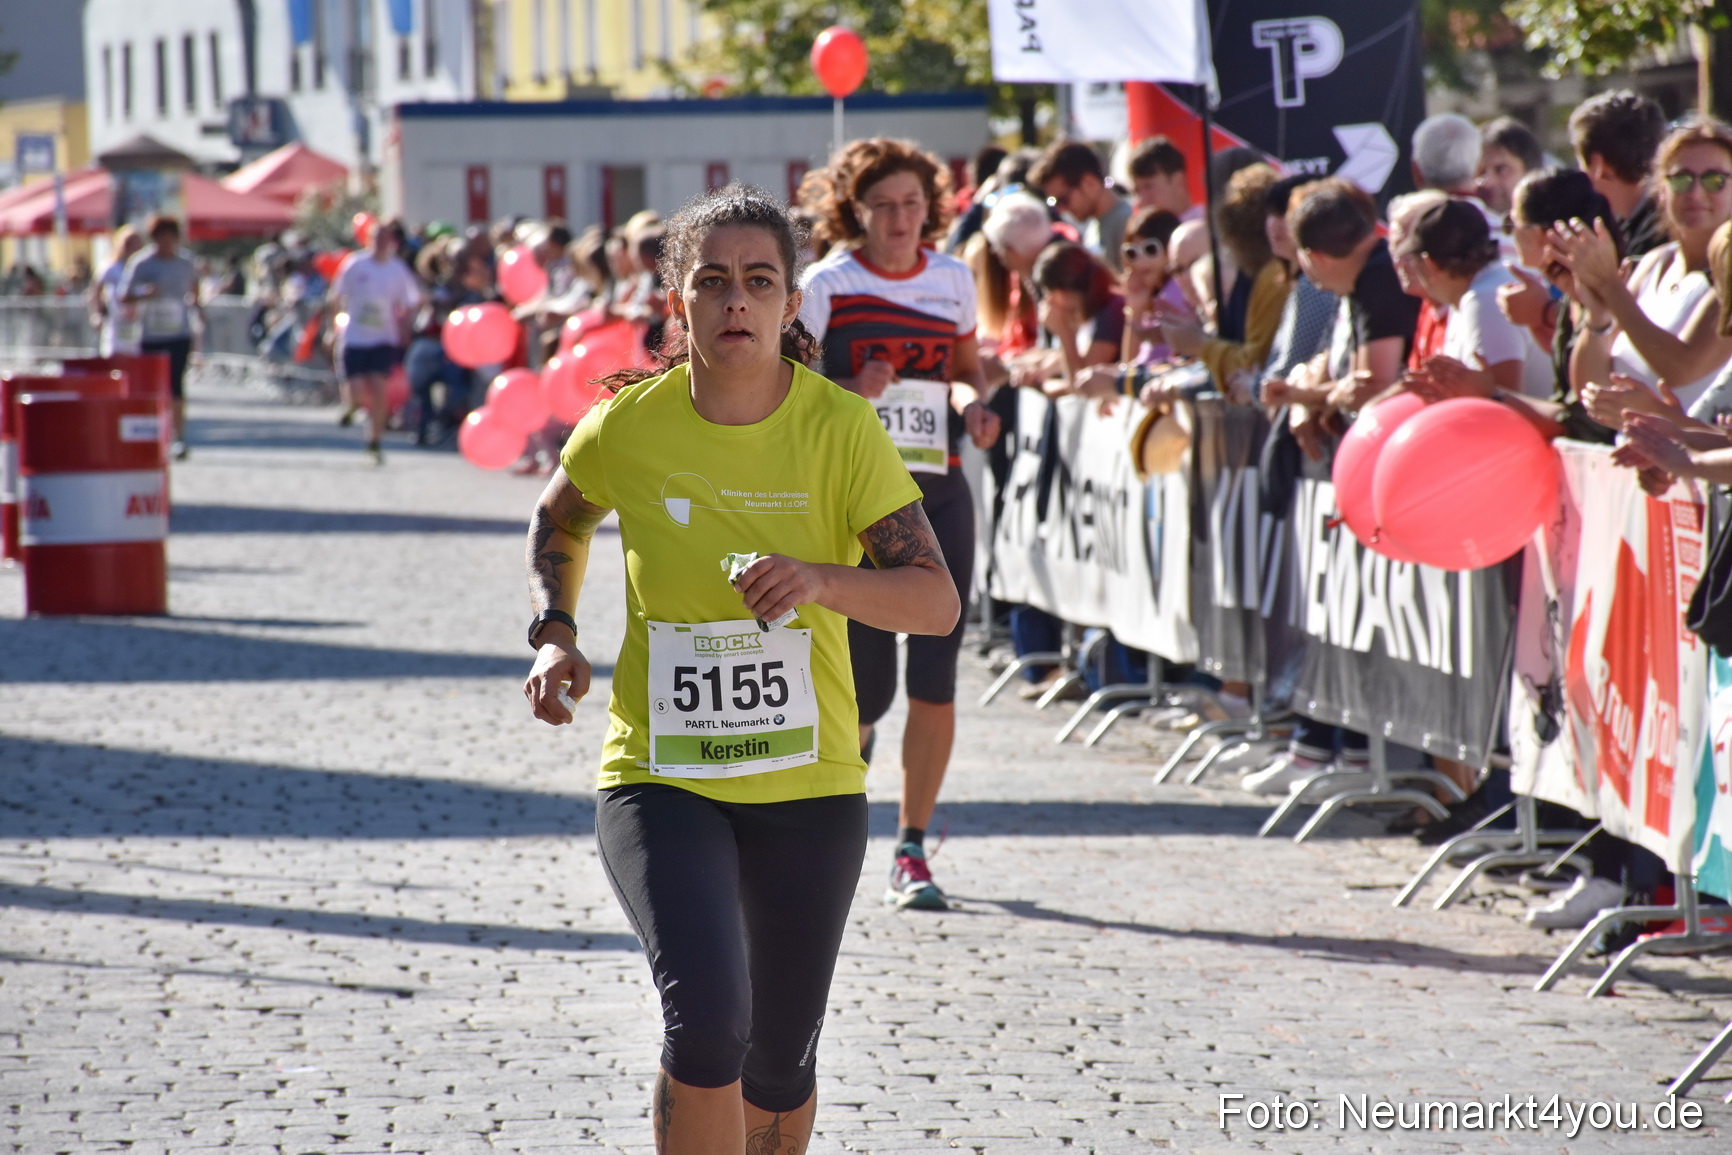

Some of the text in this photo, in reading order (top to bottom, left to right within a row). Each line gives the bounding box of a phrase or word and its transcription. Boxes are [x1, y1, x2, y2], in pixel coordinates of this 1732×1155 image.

[877, 406, 936, 435] 5139
[721, 489, 752, 498] Kliniken
[768, 491, 809, 499] Landkreises
[744, 500, 782, 508] Neumarkt
[694, 632, 763, 652] BOCK
[673, 660, 789, 712] 5155
[658, 702, 665, 711] S
[685, 717, 770, 729] PARTL Neumarkt
[701, 738, 770, 760] Kerstin
